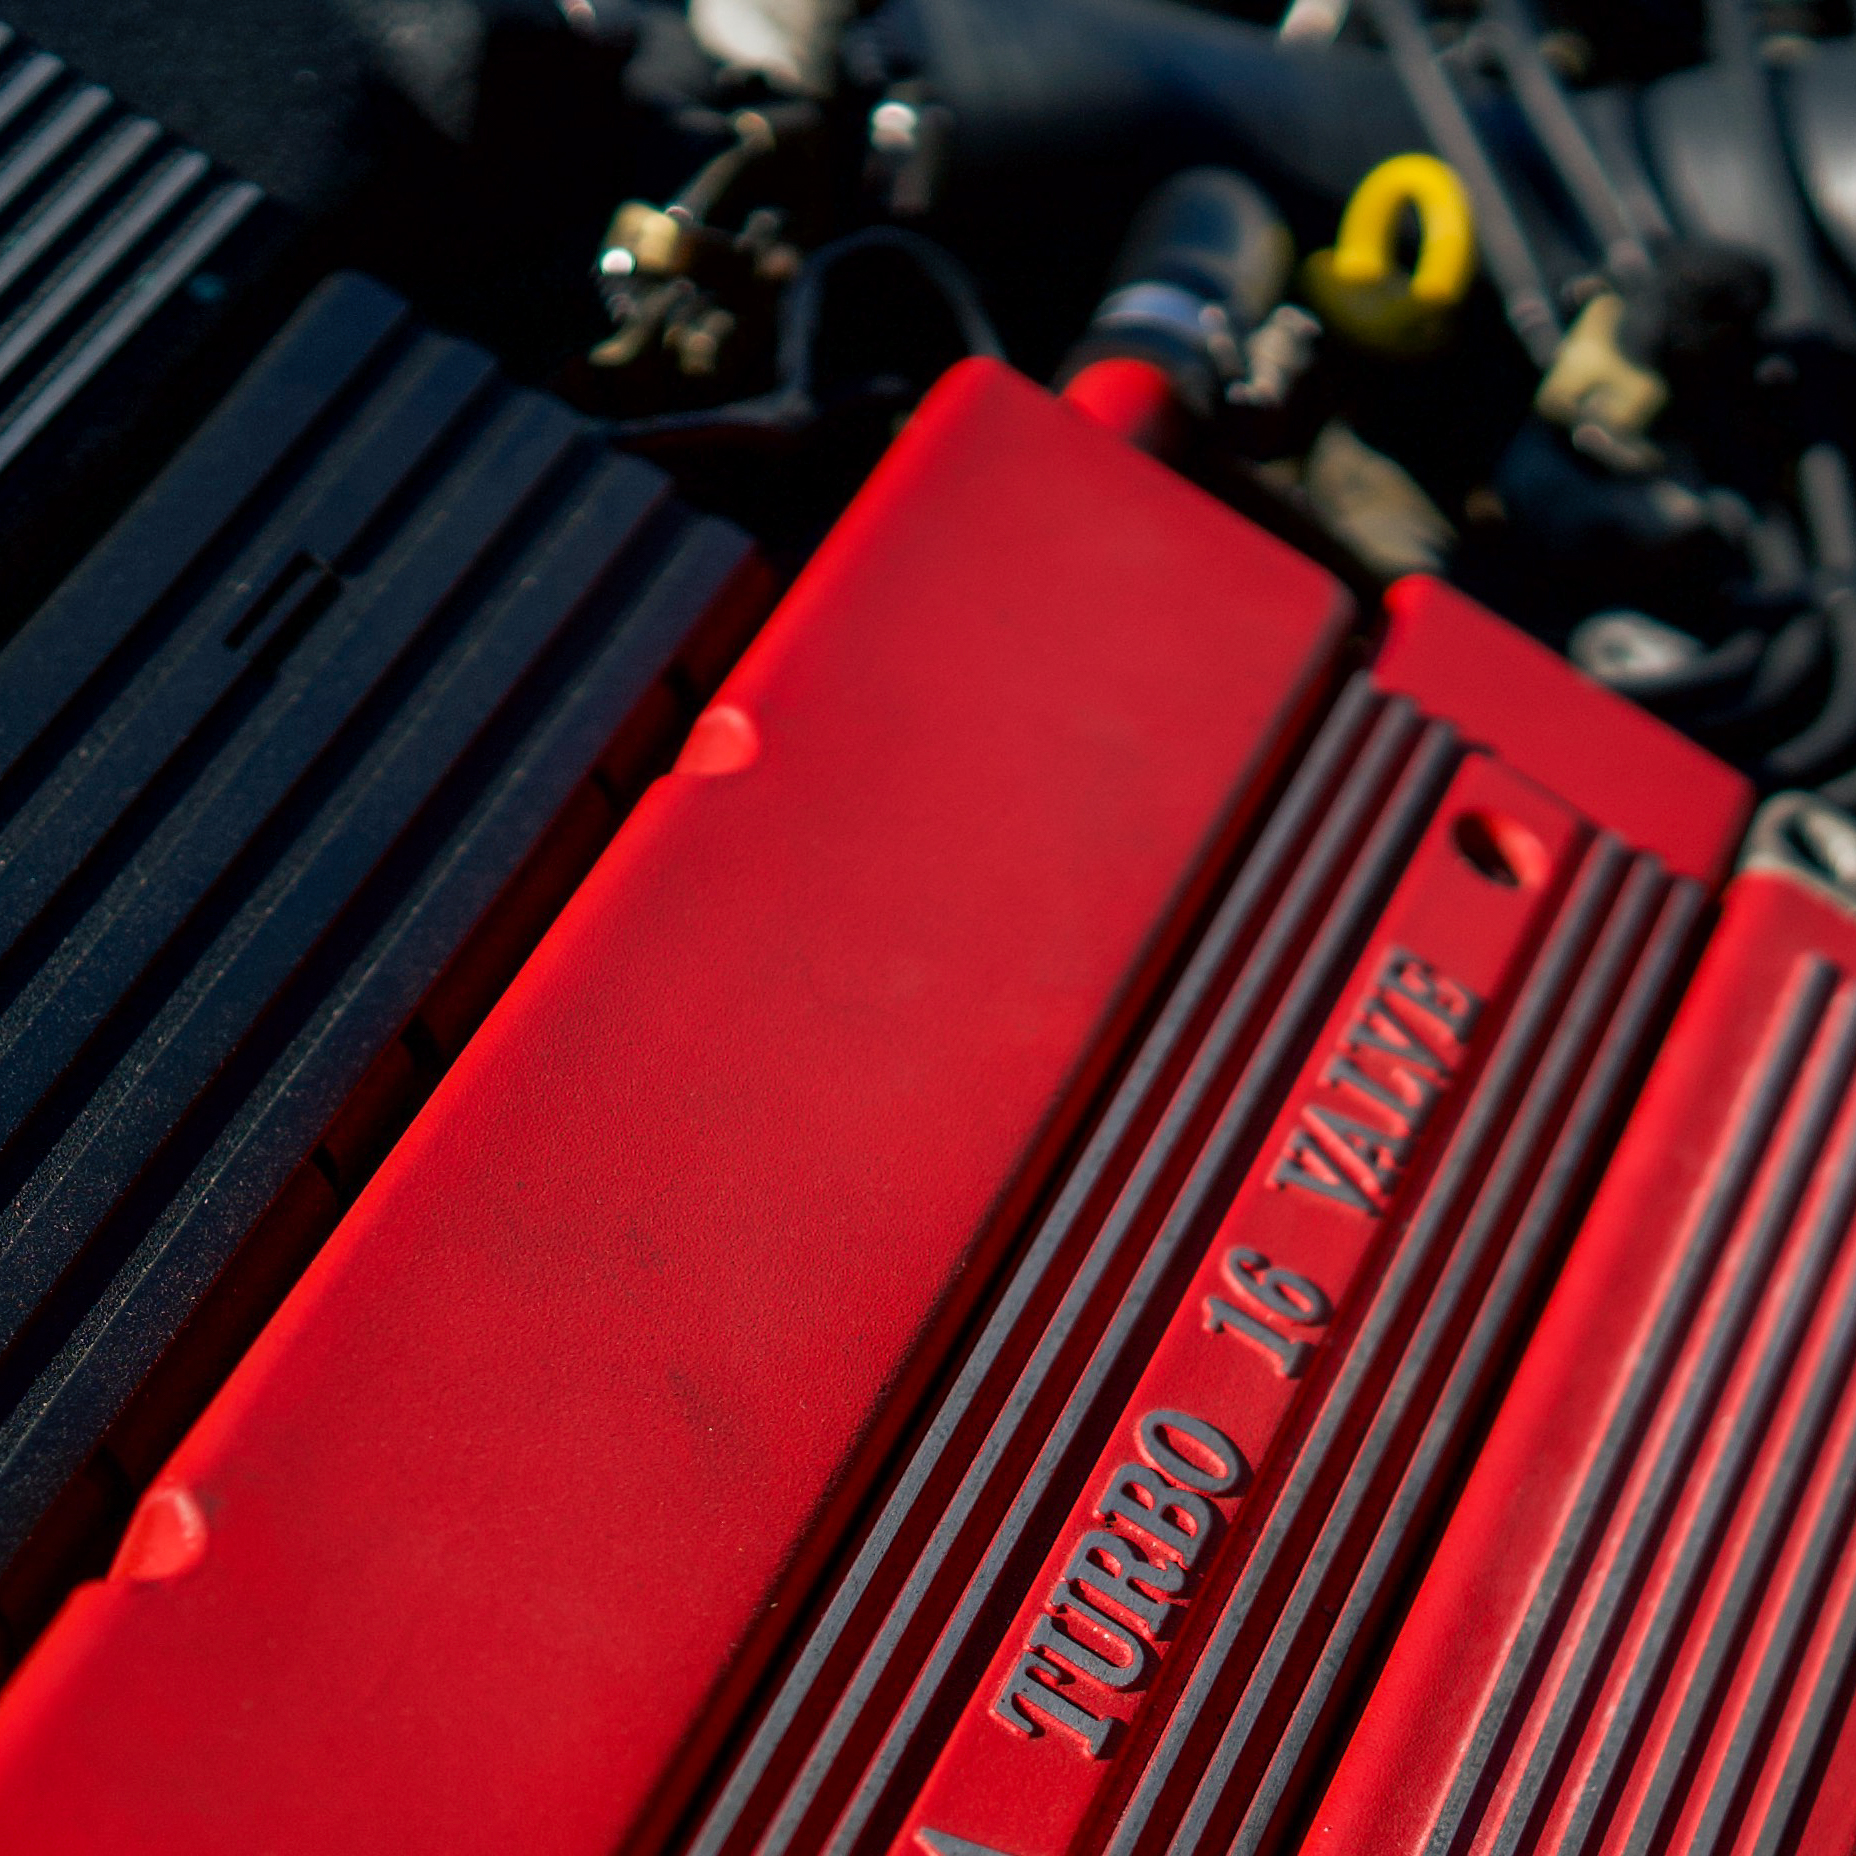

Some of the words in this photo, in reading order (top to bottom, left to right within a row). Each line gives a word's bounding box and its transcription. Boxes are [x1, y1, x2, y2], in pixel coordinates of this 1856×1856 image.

[1266, 945, 1484, 1217] VALVE
[1202, 1245, 1334, 1378] 16
[989, 1408, 1244, 1760] TURBO
